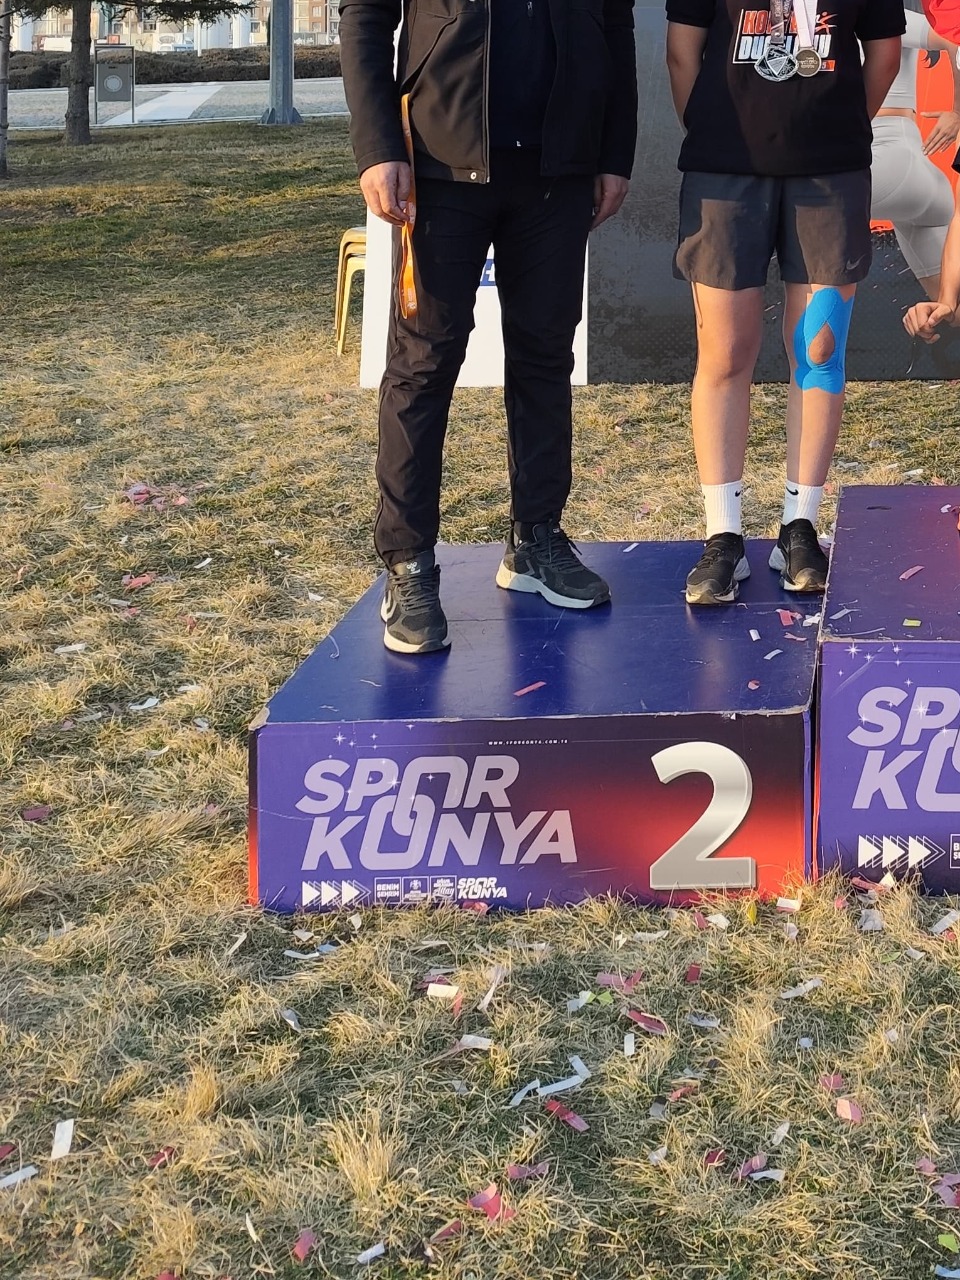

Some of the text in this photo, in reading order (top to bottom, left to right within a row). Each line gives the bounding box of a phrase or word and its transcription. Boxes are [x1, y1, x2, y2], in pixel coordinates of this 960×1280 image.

[295, 755, 520, 817] SPOR
[650, 741, 757, 891] 2
[301, 802, 579, 872] KONYA
